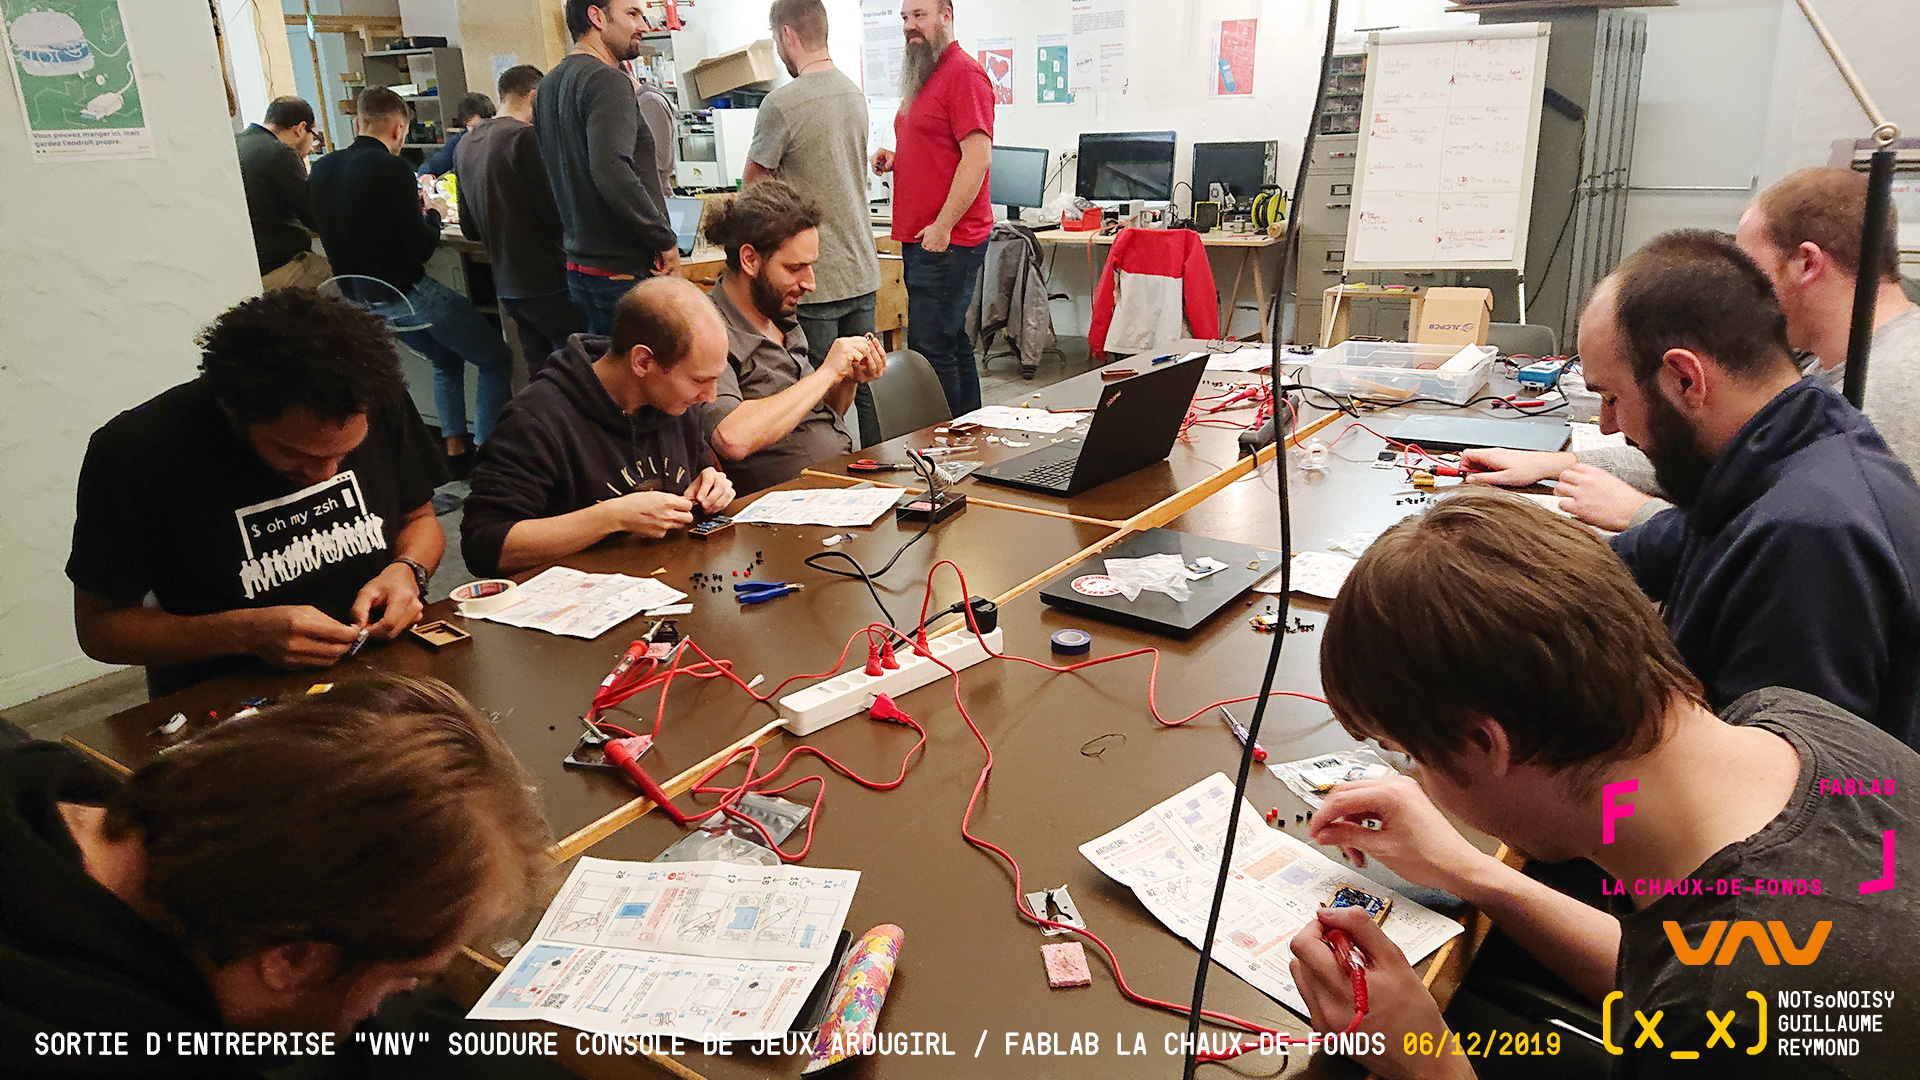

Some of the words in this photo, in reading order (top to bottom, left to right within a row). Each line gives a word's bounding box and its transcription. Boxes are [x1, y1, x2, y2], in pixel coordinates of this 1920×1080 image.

[863, 10, 886, 18] Imprimante
[251, 523, 261, 538] $
[266, 517, 287, 533] oh
[290, 510, 308, 526] my
[312, 497, 339, 517] zsh
[789, 877, 798, 886] 15
